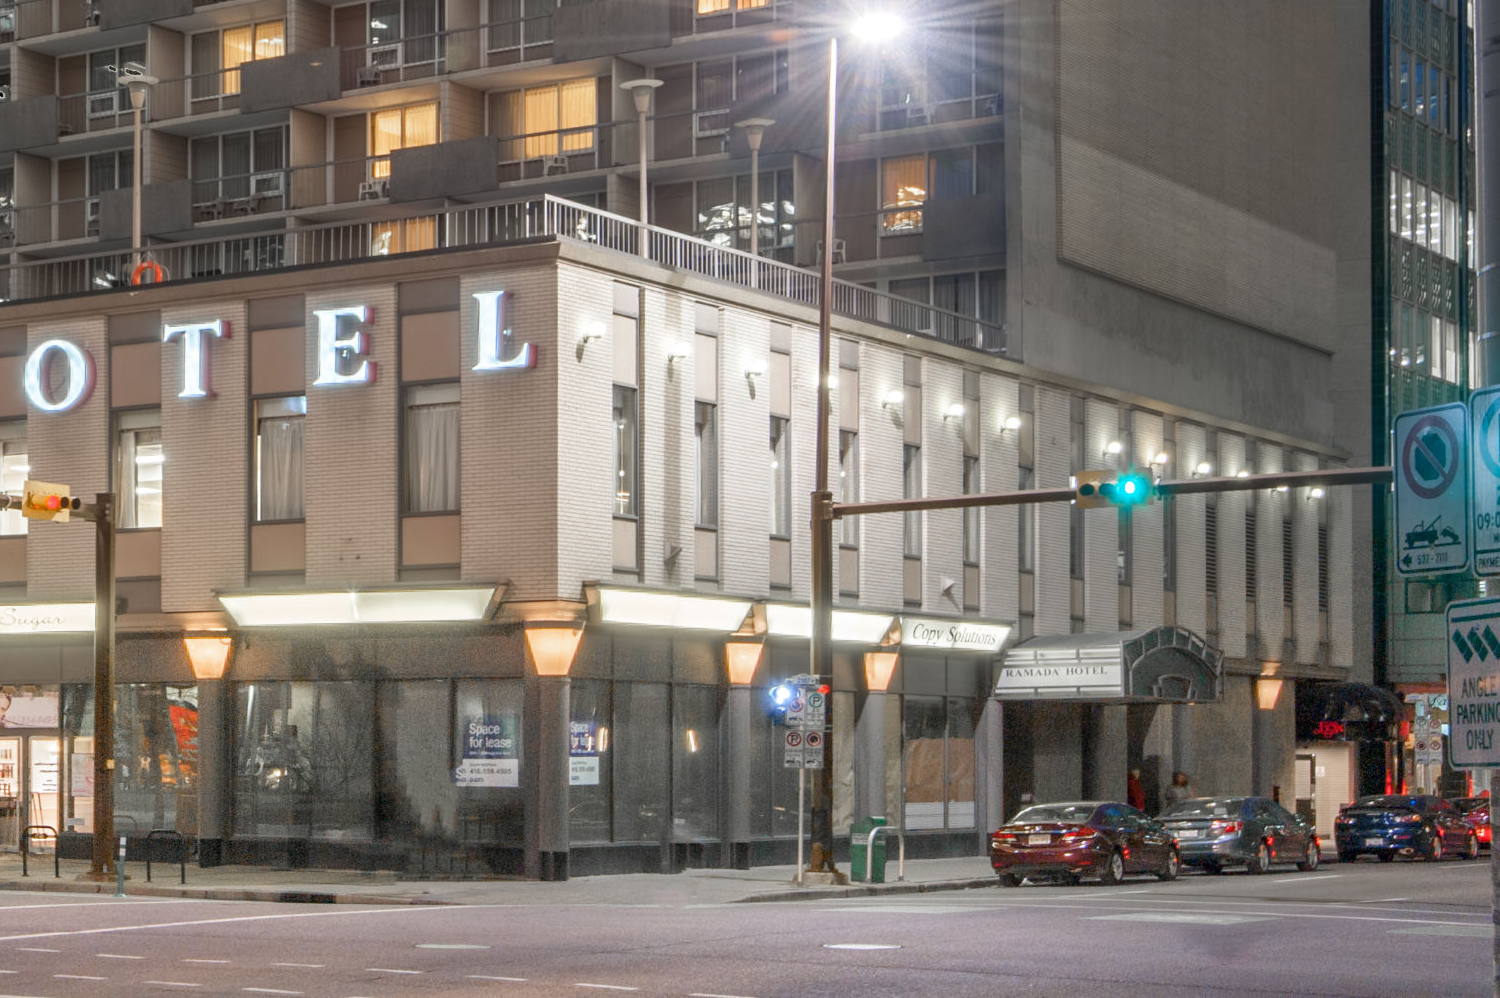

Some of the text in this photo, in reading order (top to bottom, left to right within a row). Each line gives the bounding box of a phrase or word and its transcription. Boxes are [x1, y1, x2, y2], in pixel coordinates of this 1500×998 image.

[912, 623, 996, 645] Copy Solutions
[1005, 665, 1109, 678] RAMADA HOTEL
[1461, 676, 1498, 699] ANGLE
[1456, 702, 1500, 725] PARKING
[469, 723, 500, 736] Space
[1466, 728, 1494, 750] ONLY
[469, 736, 512, 748] for lease
